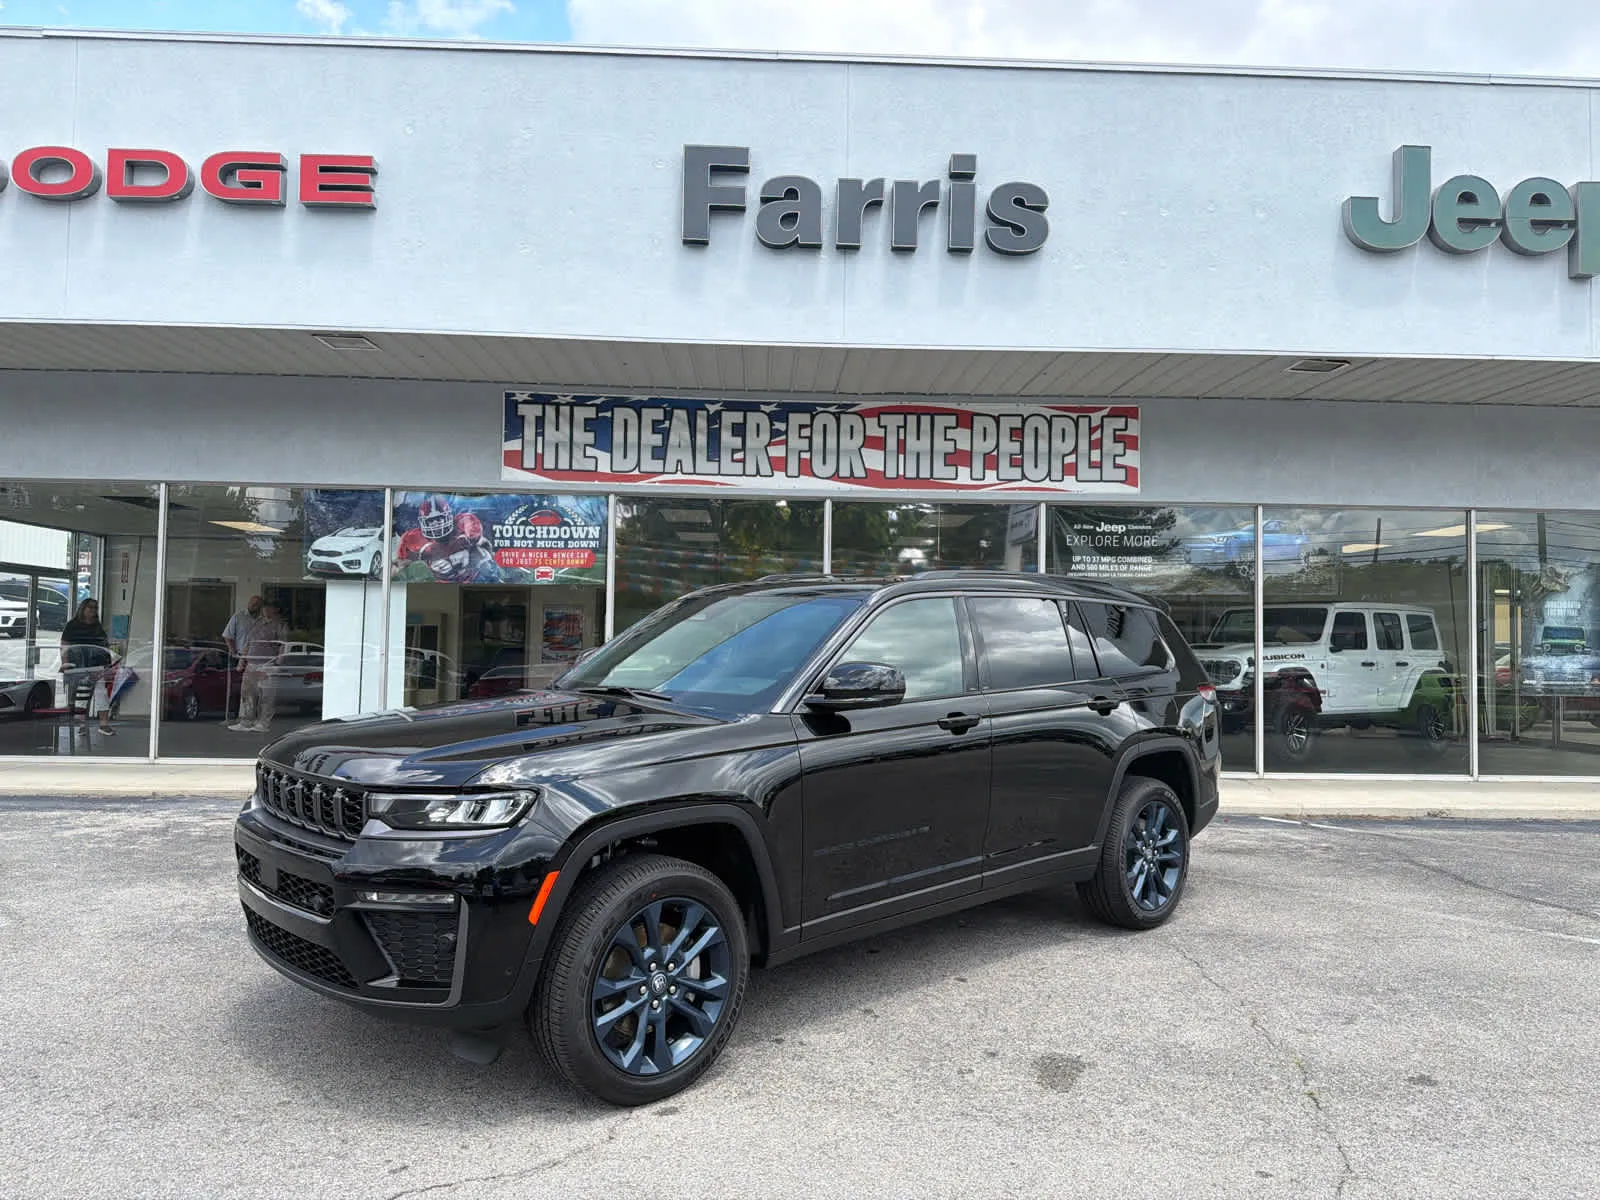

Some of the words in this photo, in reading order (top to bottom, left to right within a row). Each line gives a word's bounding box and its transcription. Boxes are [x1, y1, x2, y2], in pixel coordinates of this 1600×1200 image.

[0, 145, 378, 211] ODGE
[681, 144, 1050, 256] Farris
[516, 402, 599, 472] THE
[610, 405, 774, 478] DEALER
[785, 410, 868, 480] FOR
[878, 412, 958, 481] THE
[970, 413, 1129, 482] PEOPLE
[492, 525, 600, 539] TOUCHDOWN
[1095, 521, 1126, 534] Jeep
[494, 539, 511, 547] FOR
[513, 540, 534, 548] NOT
[536, 540, 565, 548] MUCH
[567, 540, 600, 549] DOWN!
[1066, 534, 1121, 547] EXPLORE
[1123, 535, 1160, 547] MORE
